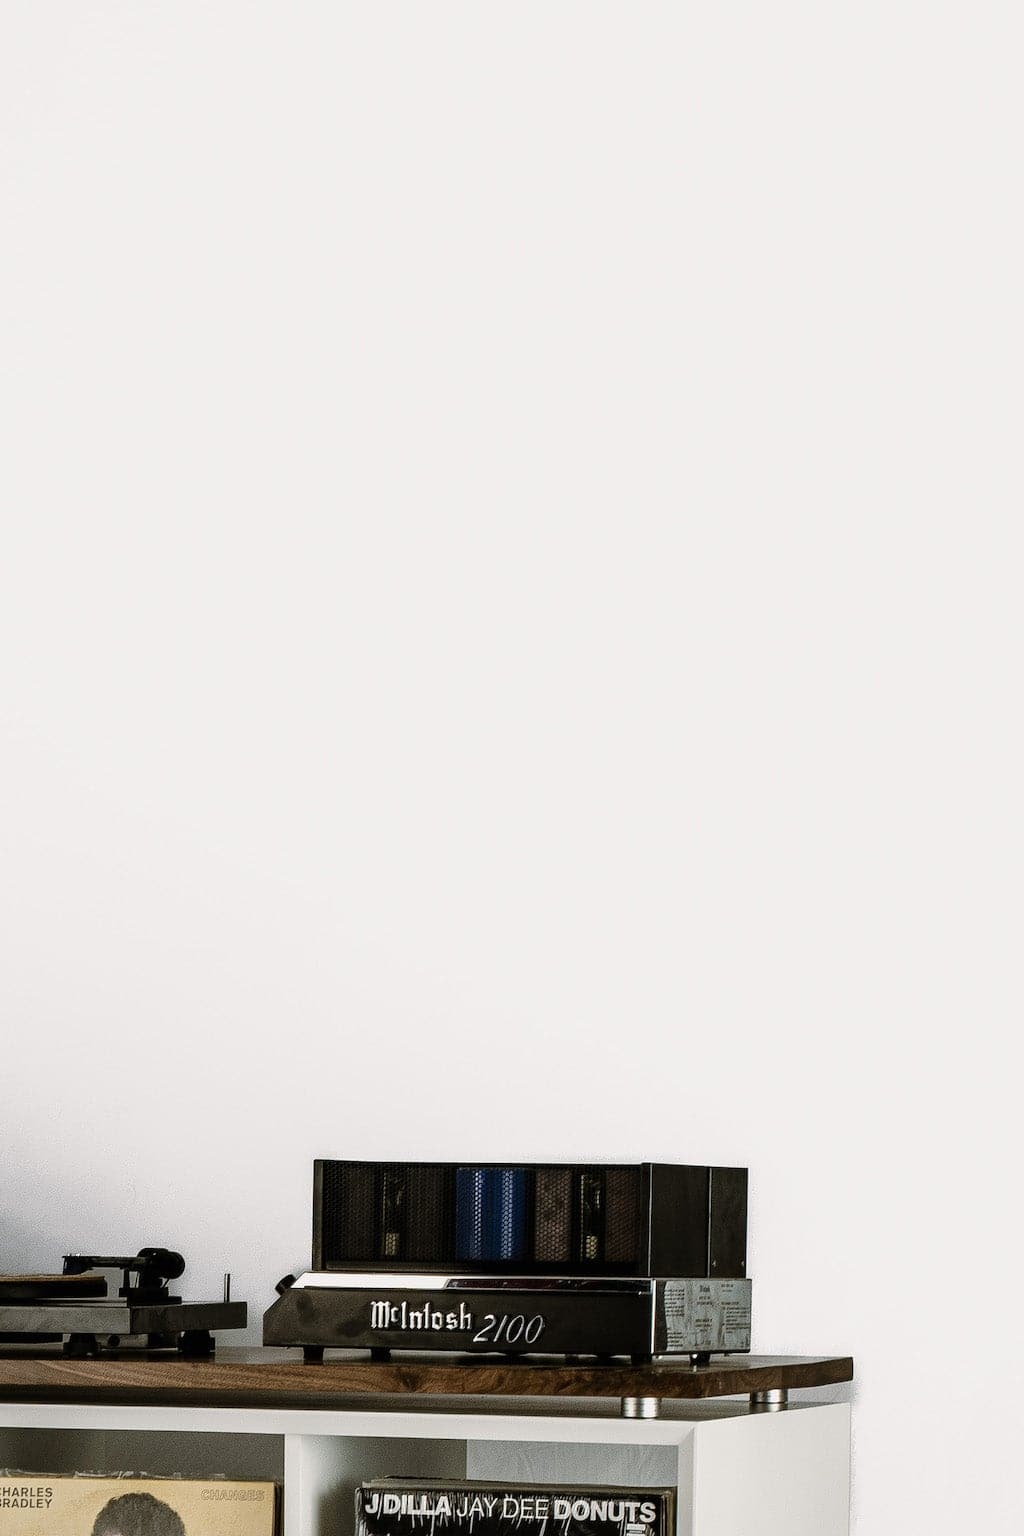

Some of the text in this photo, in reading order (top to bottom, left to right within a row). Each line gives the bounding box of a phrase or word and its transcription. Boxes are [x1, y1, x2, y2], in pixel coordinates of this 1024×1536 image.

[370, 1300, 544, 1344] McIntosh 2100
[456, 1497, 498, 1518] JAY
[502, 1499, 549, 1520] DEE
[553, 1500, 657, 1523] DONUTS
